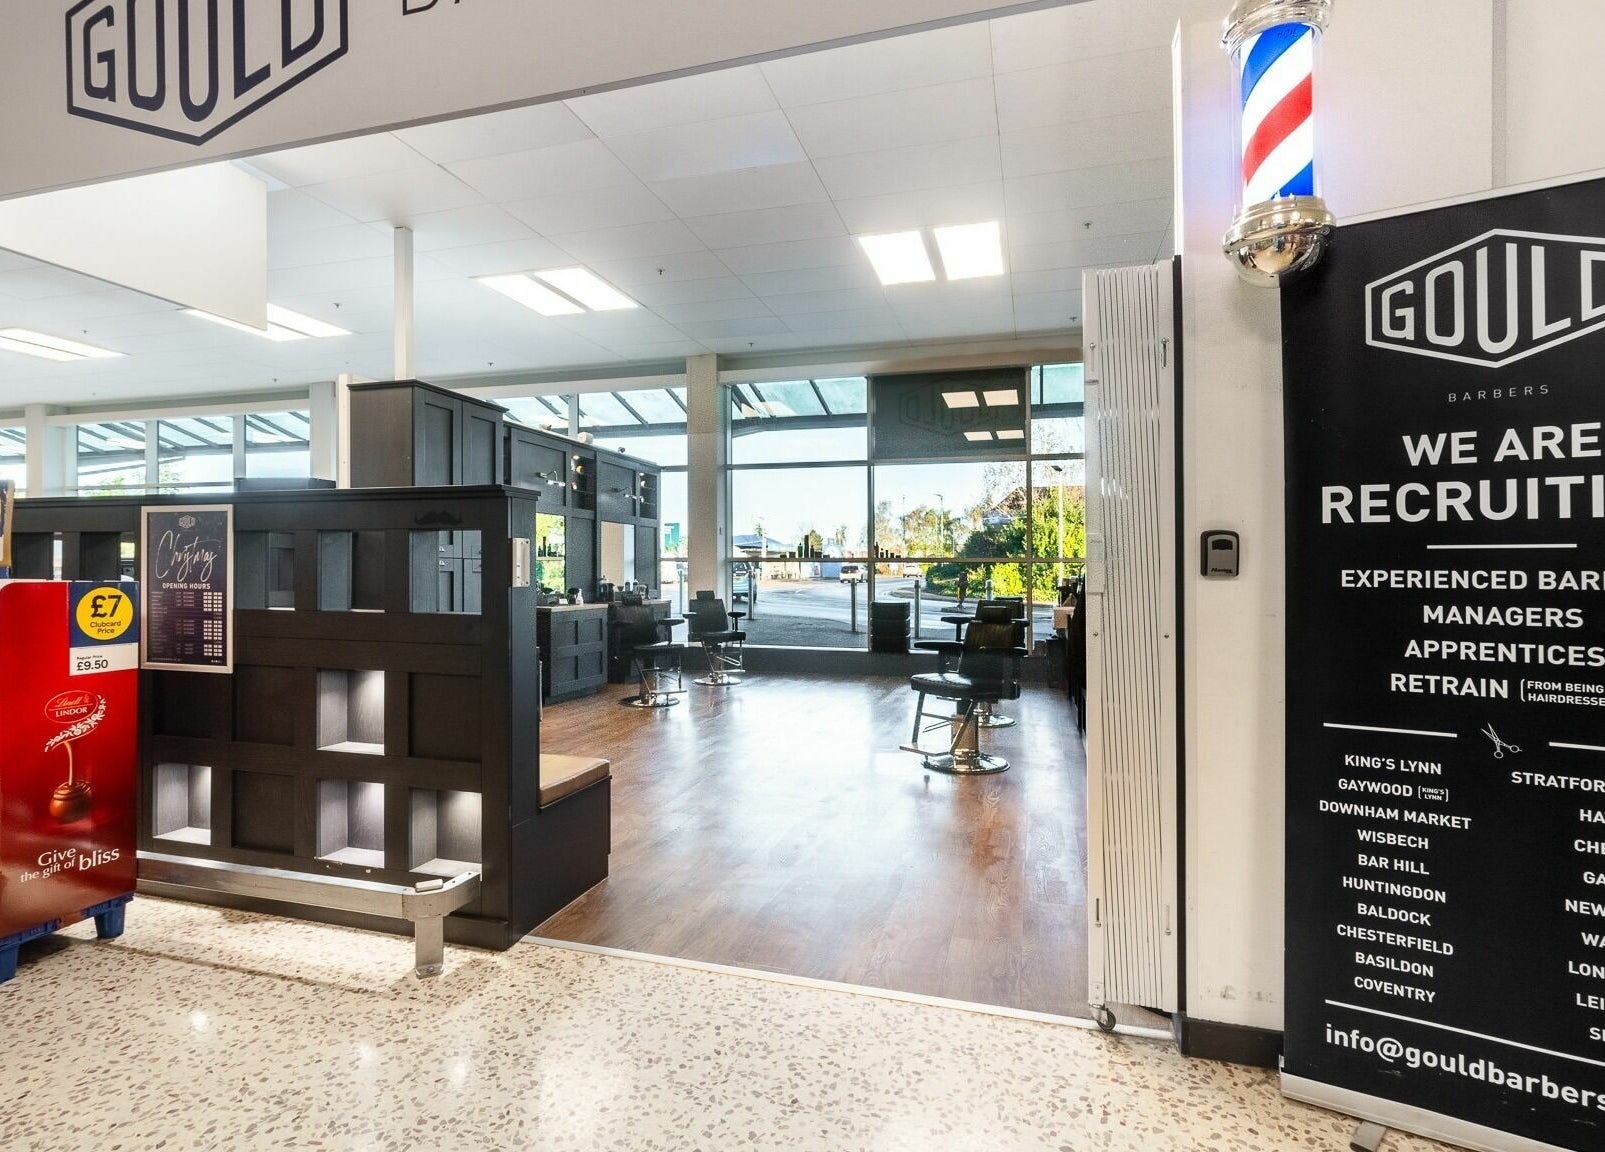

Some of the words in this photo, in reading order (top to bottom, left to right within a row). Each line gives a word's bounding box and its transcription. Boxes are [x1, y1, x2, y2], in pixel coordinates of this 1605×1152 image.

[1448, 385, 1549, 403] BARBERS
[1402, 431, 1478, 467] WE
[1494, 422, 1602, 463] ARE
[162, 582, 188, 590] OPENING
[1341, 569, 1528, 590] EXPERIENCED
[1539, 570, 1605, 590] BAR
[91, 594, 122, 618] £7
[1423, 604, 1584, 627] MANAGERS
[90, 620, 122, 629] Clubcard
[1404, 640, 1605, 666] APPRENTICES
[77, 660, 109, 671] £9.50
[1390, 673, 1508, 698] RETRAIN
[1527, 680, 1562, 691] FROM
[1565, 683, 1605, 694] BEING
[56, 707, 88, 717] LINDOR
[1344, 755, 1396, 771] KING'S
[1400, 760, 1442, 775] LYNN
[1338, 778, 1413, 797] GAYWOOD
[1319, 799, 1399, 821] DOWNHAM
[1404, 810, 1472, 829] MARKET
[1580, 809, 1605, 824] HA
[1357, 828, 1429, 850] WISBECH
[20, 871, 40, 883] the
[42, 862, 61, 878] gift
[64, 857, 76, 869] of
[79, 848, 120, 871] bliss
[38, 848, 77, 866] Give
[1358, 854, 1389, 870] BAR
[1394, 859, 1430, 875] HILL
[1342, 876, 1446, 903] HUNTINGDON
[1357, 903, 1432, 927] BALDOCK
[1336, 924, 1454, 955] CHESTERFIELD
[1355, 952, 1434, 977] BASILDON
[1353, 977, 1436, 1003] COVENTRY
